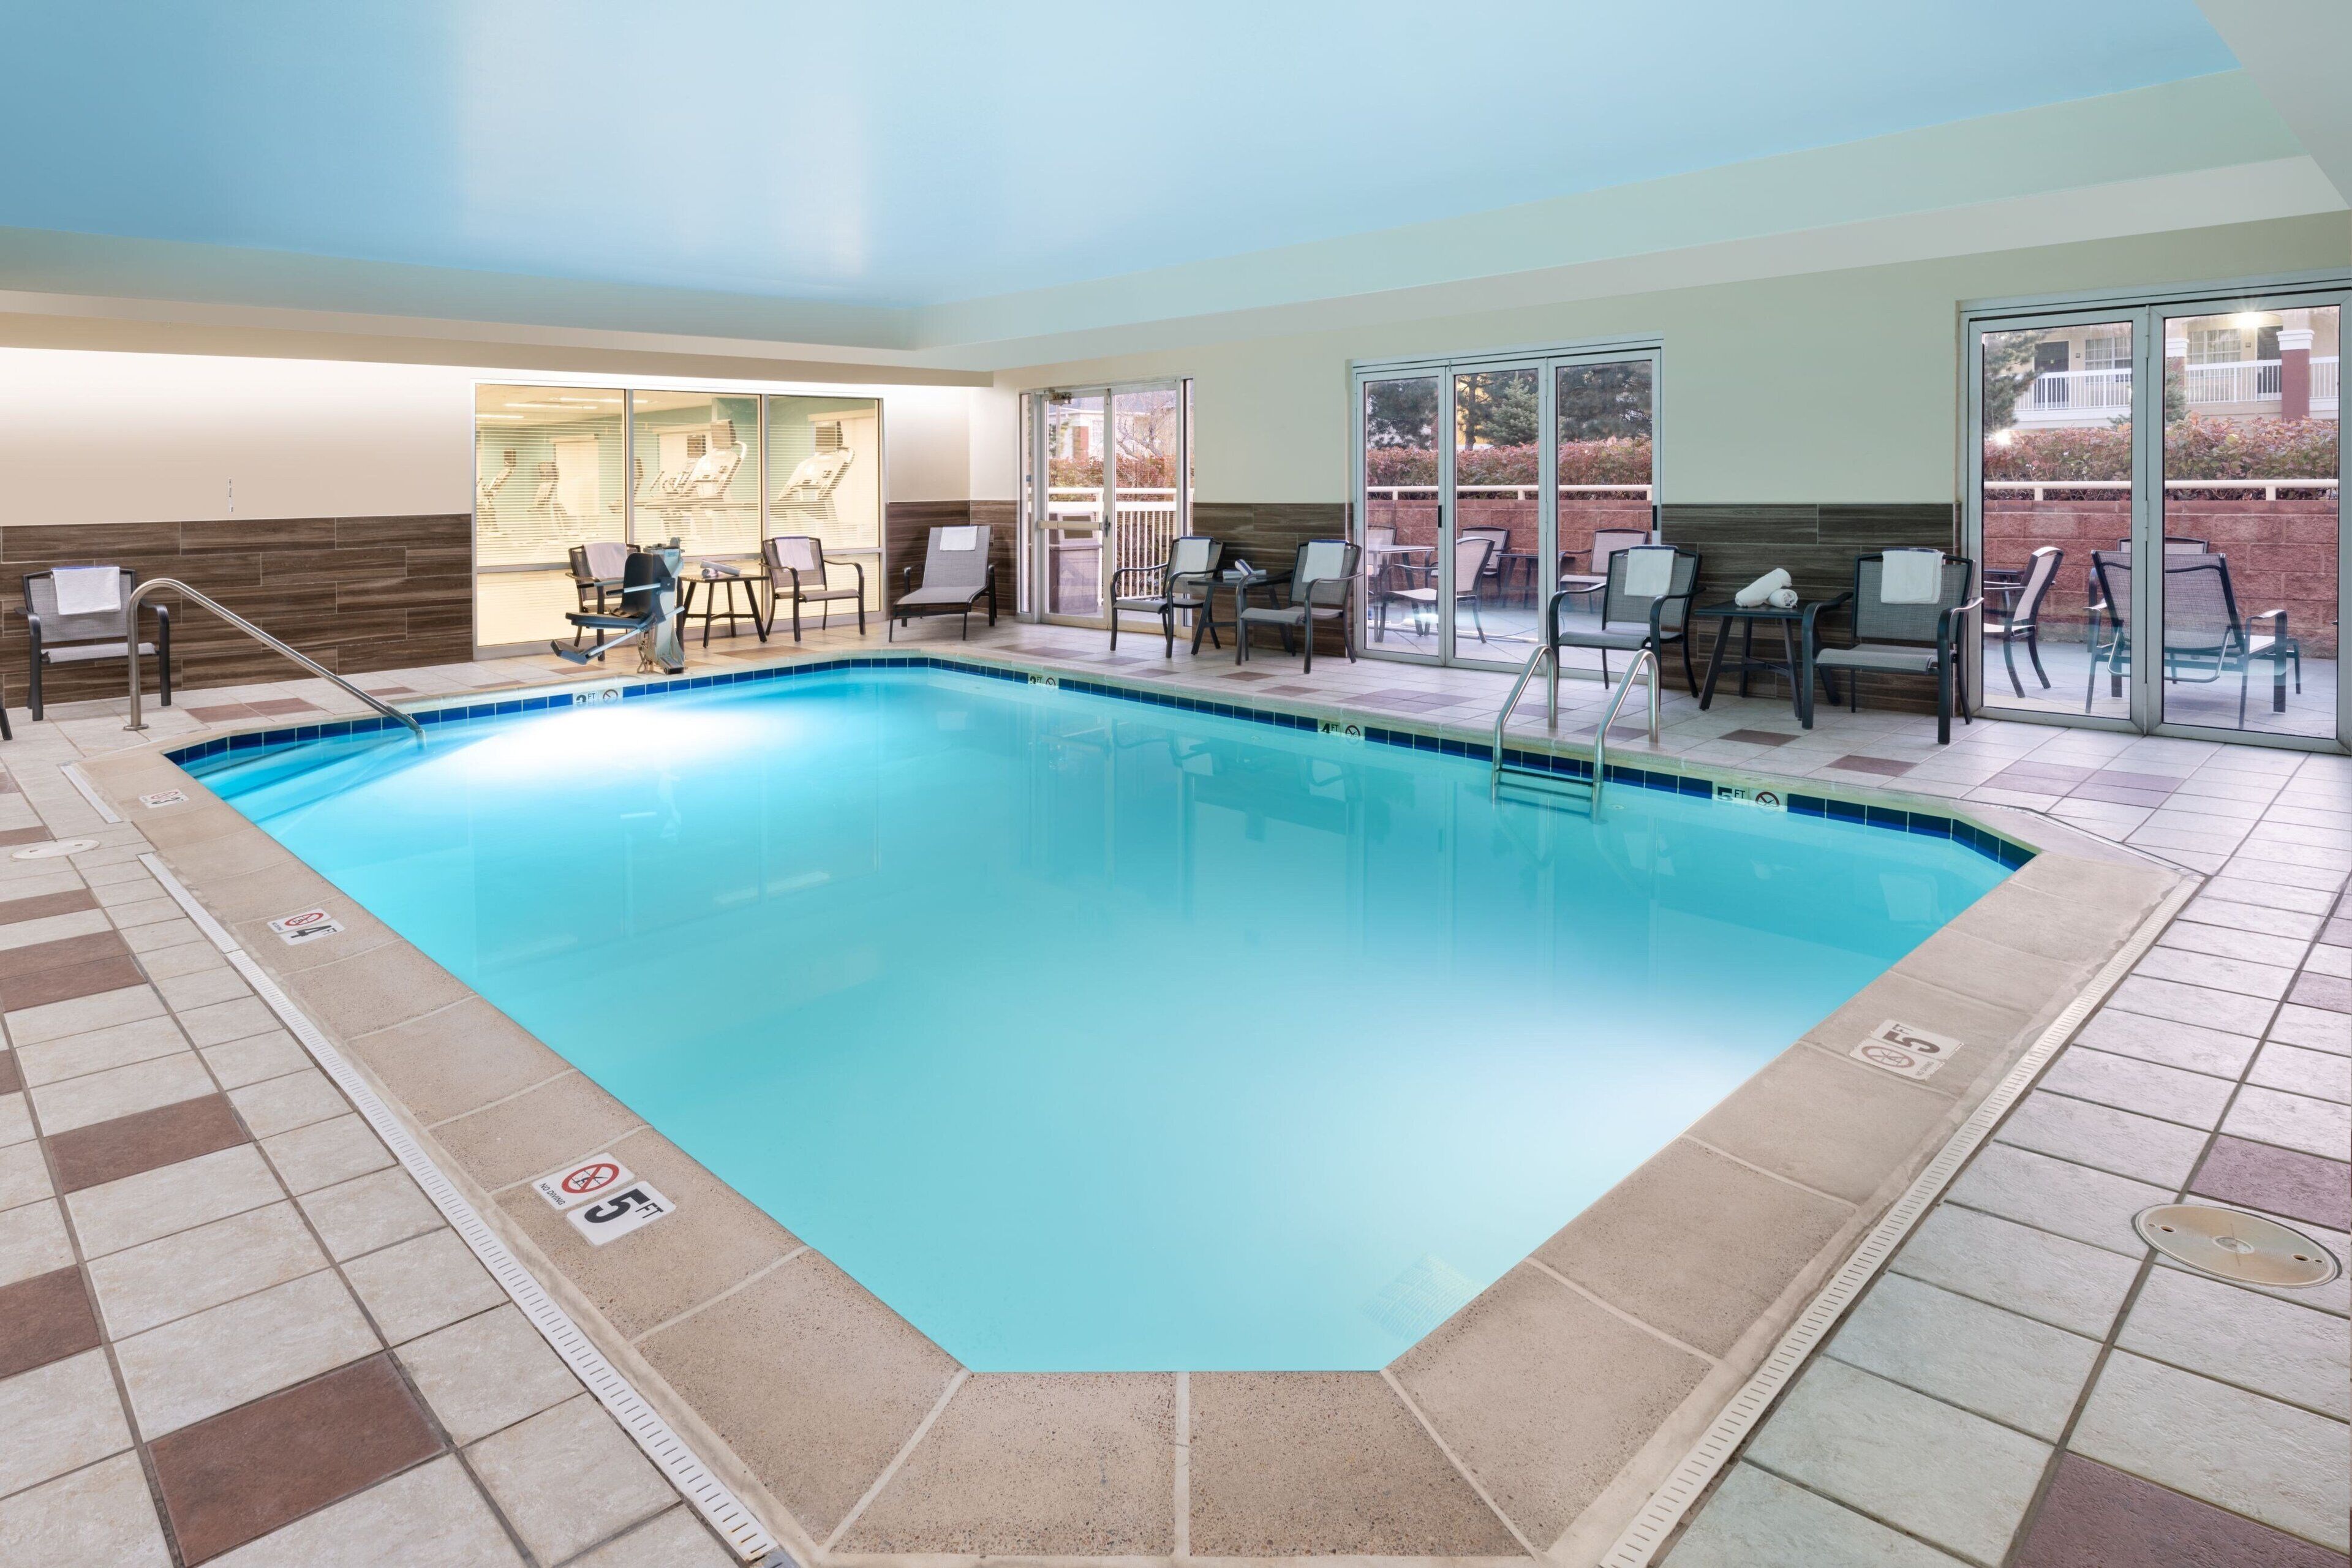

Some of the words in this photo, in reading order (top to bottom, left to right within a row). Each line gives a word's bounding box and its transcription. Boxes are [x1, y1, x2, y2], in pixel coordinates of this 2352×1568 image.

[1735, 789, 1745, 799] FT
[290, 925, 332, 938] 4
[1891, 1023, 1913, 1035] FT
[1882, 1030, 1940, 1054] 5
[546, 1190, 565, 1205] DIVING
[584, 1188, 650, 1223] 5
[635, 1202, 664, 1218] FT
